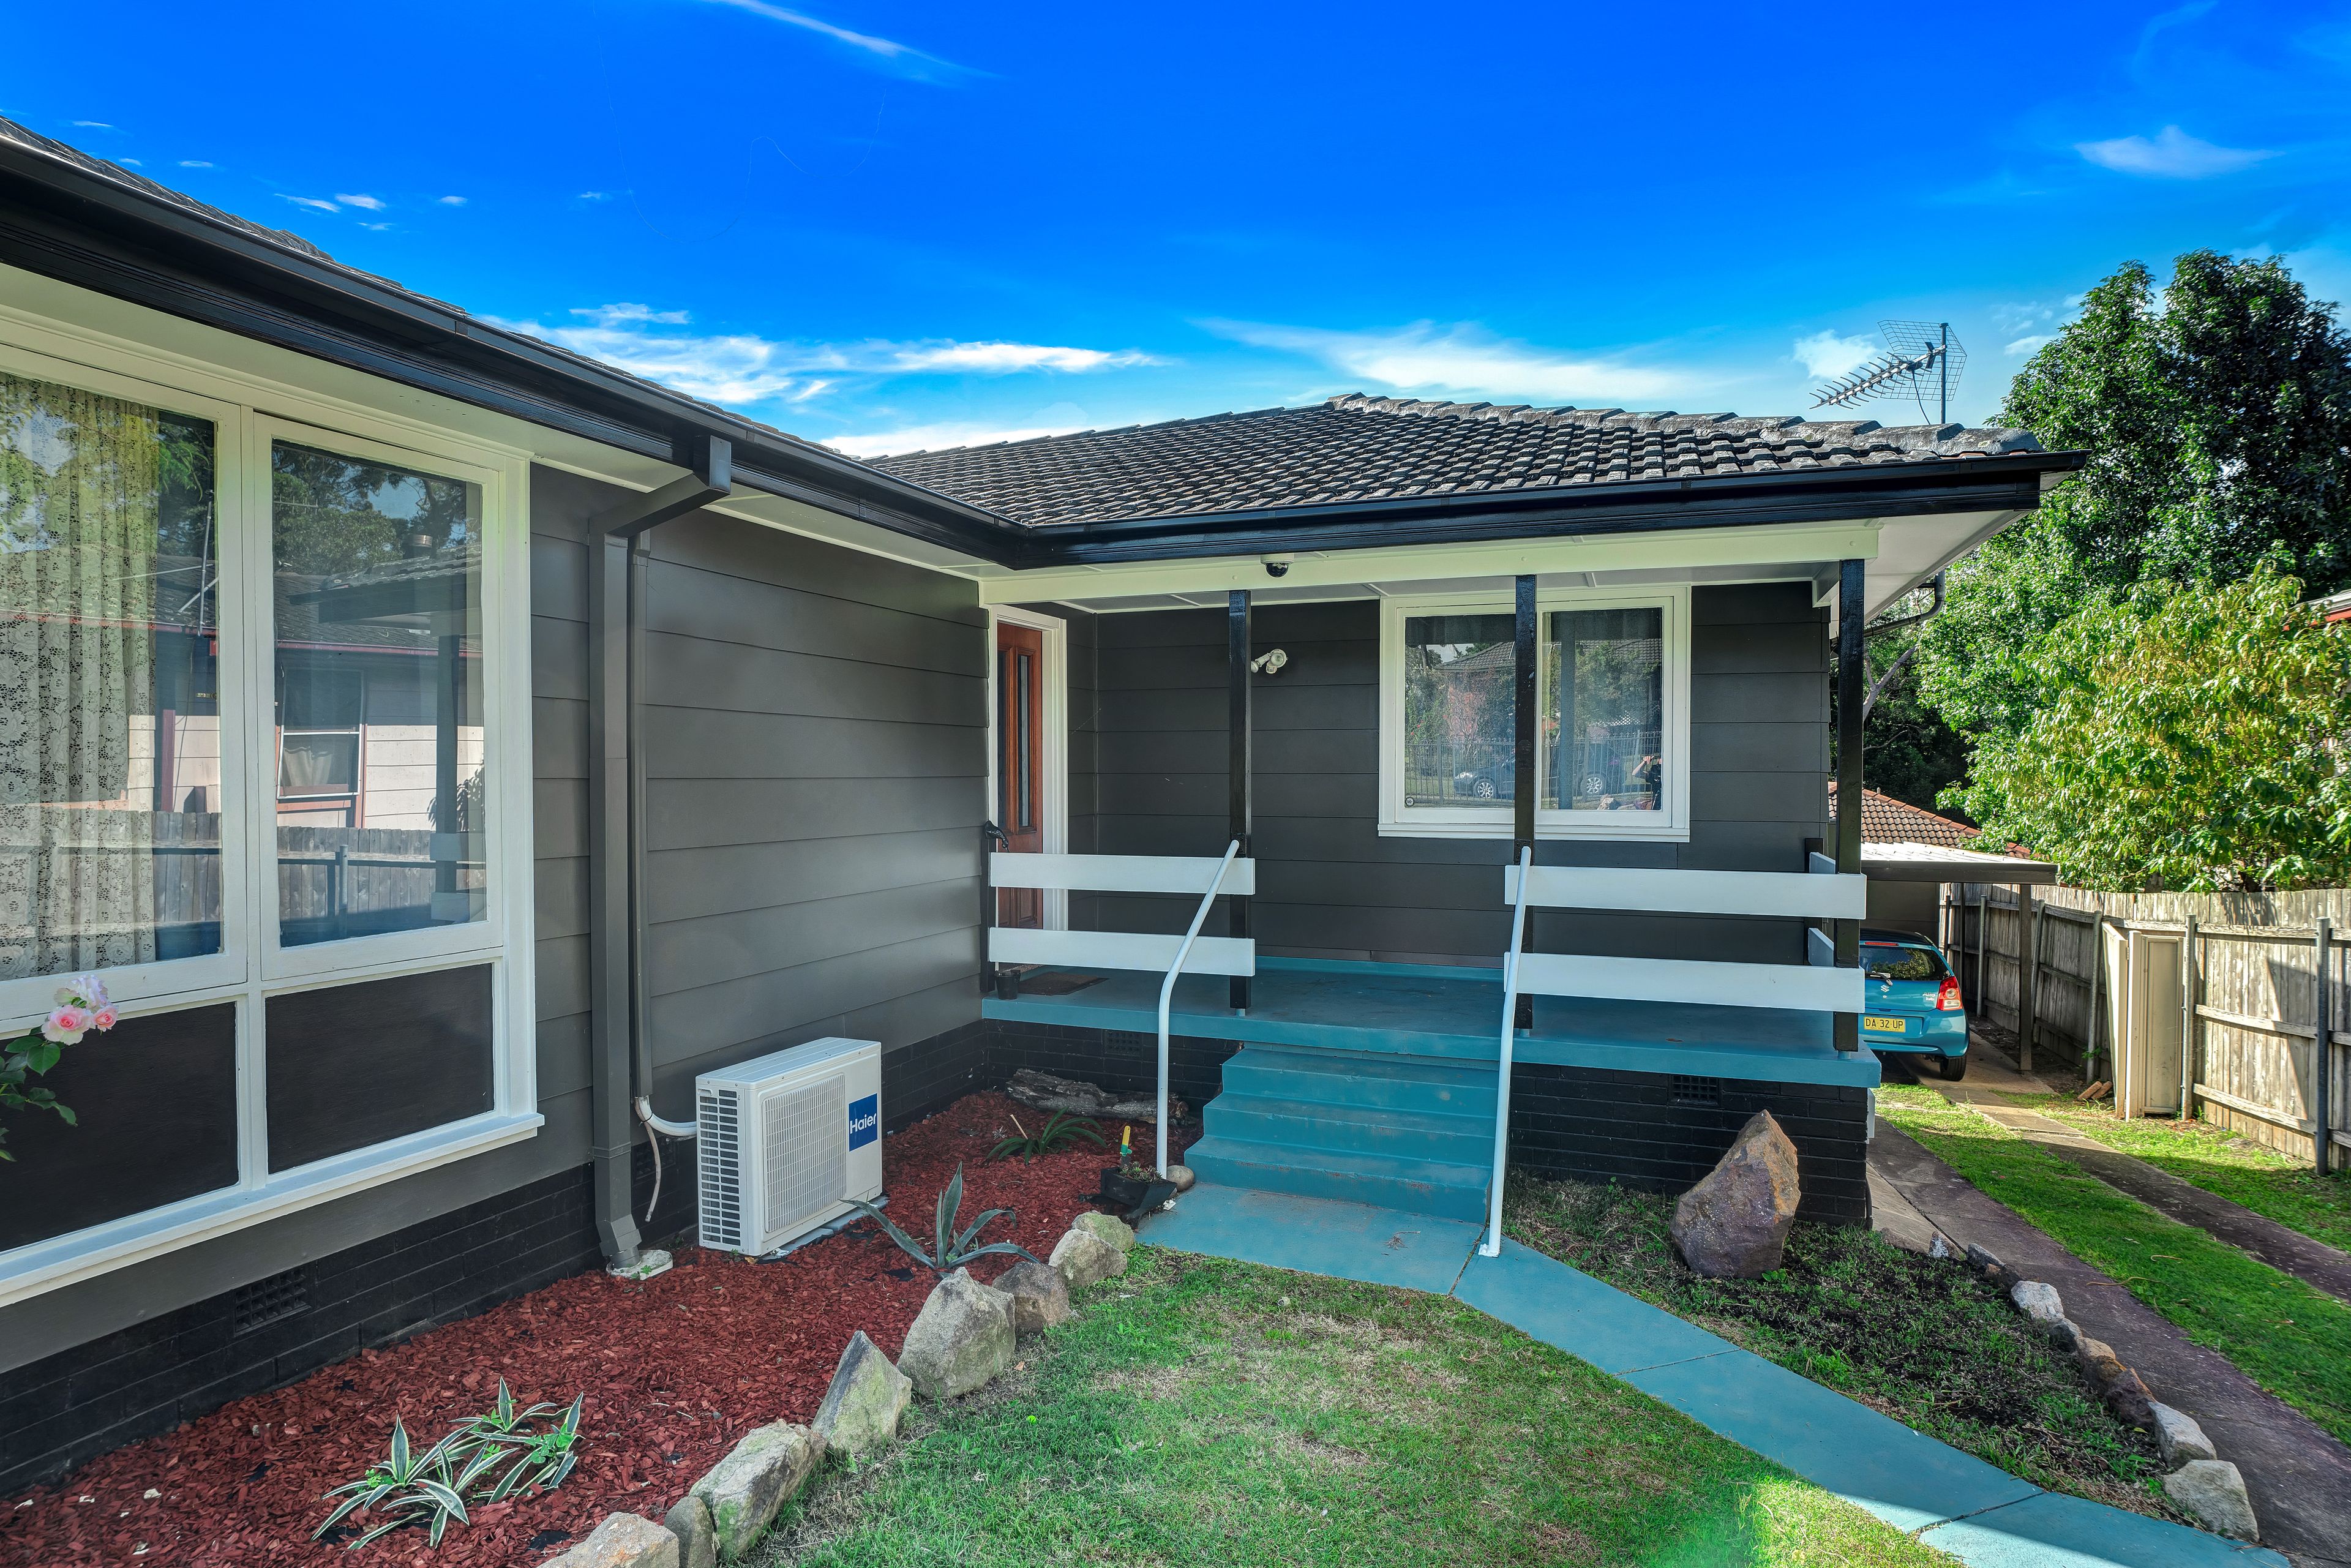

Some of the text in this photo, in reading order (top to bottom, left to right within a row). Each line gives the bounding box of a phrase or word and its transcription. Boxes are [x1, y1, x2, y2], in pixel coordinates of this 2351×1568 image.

[1865, 1018, 1903, 1029] DA 32 UP
[850, 1113, 876, 1134] Haier
